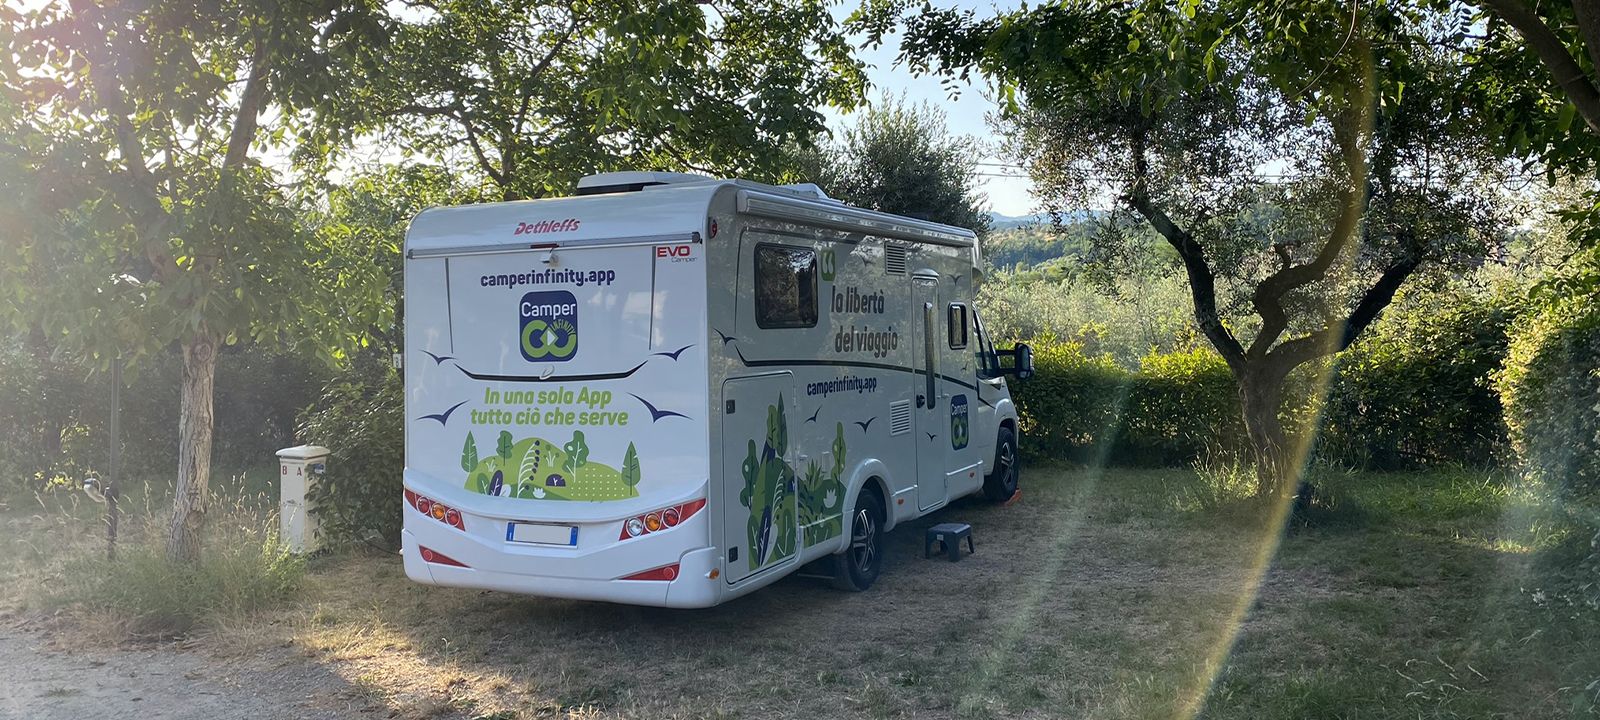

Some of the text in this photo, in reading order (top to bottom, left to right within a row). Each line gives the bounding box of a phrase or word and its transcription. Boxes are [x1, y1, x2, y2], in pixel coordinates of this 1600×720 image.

[514, 218, 580, 235] Dethleffs
[657, 246, 690, 257] EVO
[480, 268, 616, 289] camperinfinity.app
[831, 286, 885, 314] la libertà
[521, 302, 576, 320] Camper
[550, 318, 576, 335] INFINITY
[835, 324, 898, 358] del viaggio
[806, 376, 877, 398] camperinfinity.app
[484, 386, 612, 409] In una sola App
[470, 408, 629, 427] tutto ciò che serve
[951, 403, 968, 416] Camper
[282, 466, 302, 476] B A
